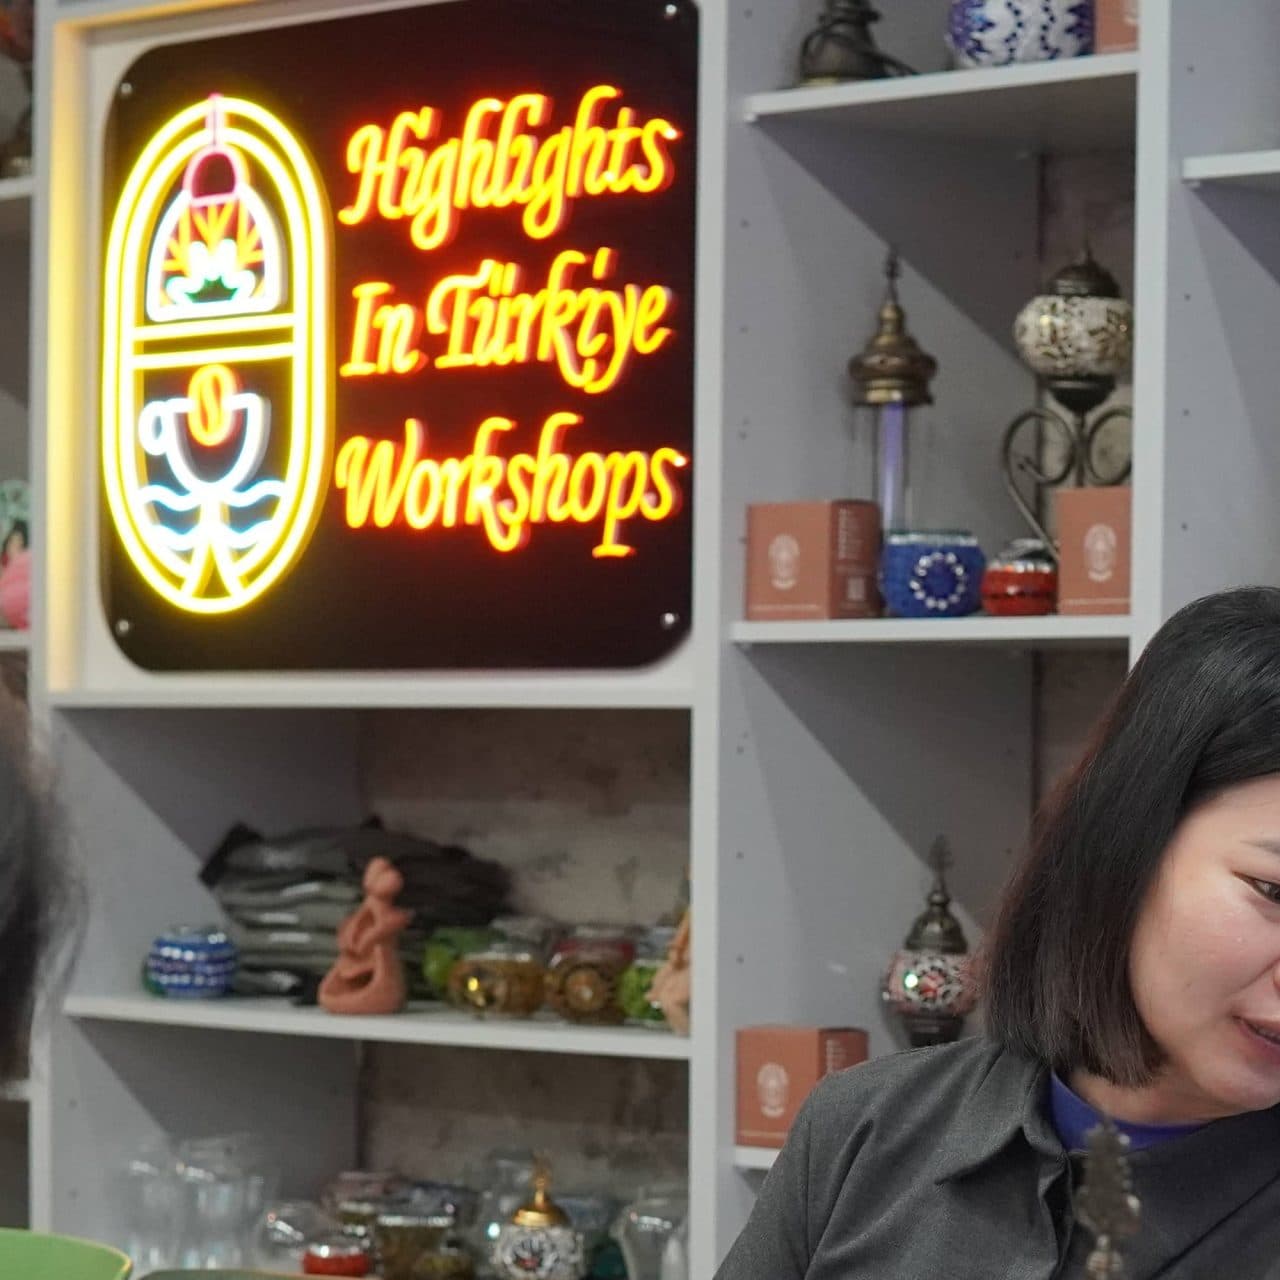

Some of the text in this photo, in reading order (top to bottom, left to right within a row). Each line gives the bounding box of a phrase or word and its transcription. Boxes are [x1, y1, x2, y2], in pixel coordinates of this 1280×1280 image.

[337, 84, 680, 251] Highlights
[339, 247, 673, 395] In Türkiye
[334, 411, 688, 558] Workshops
